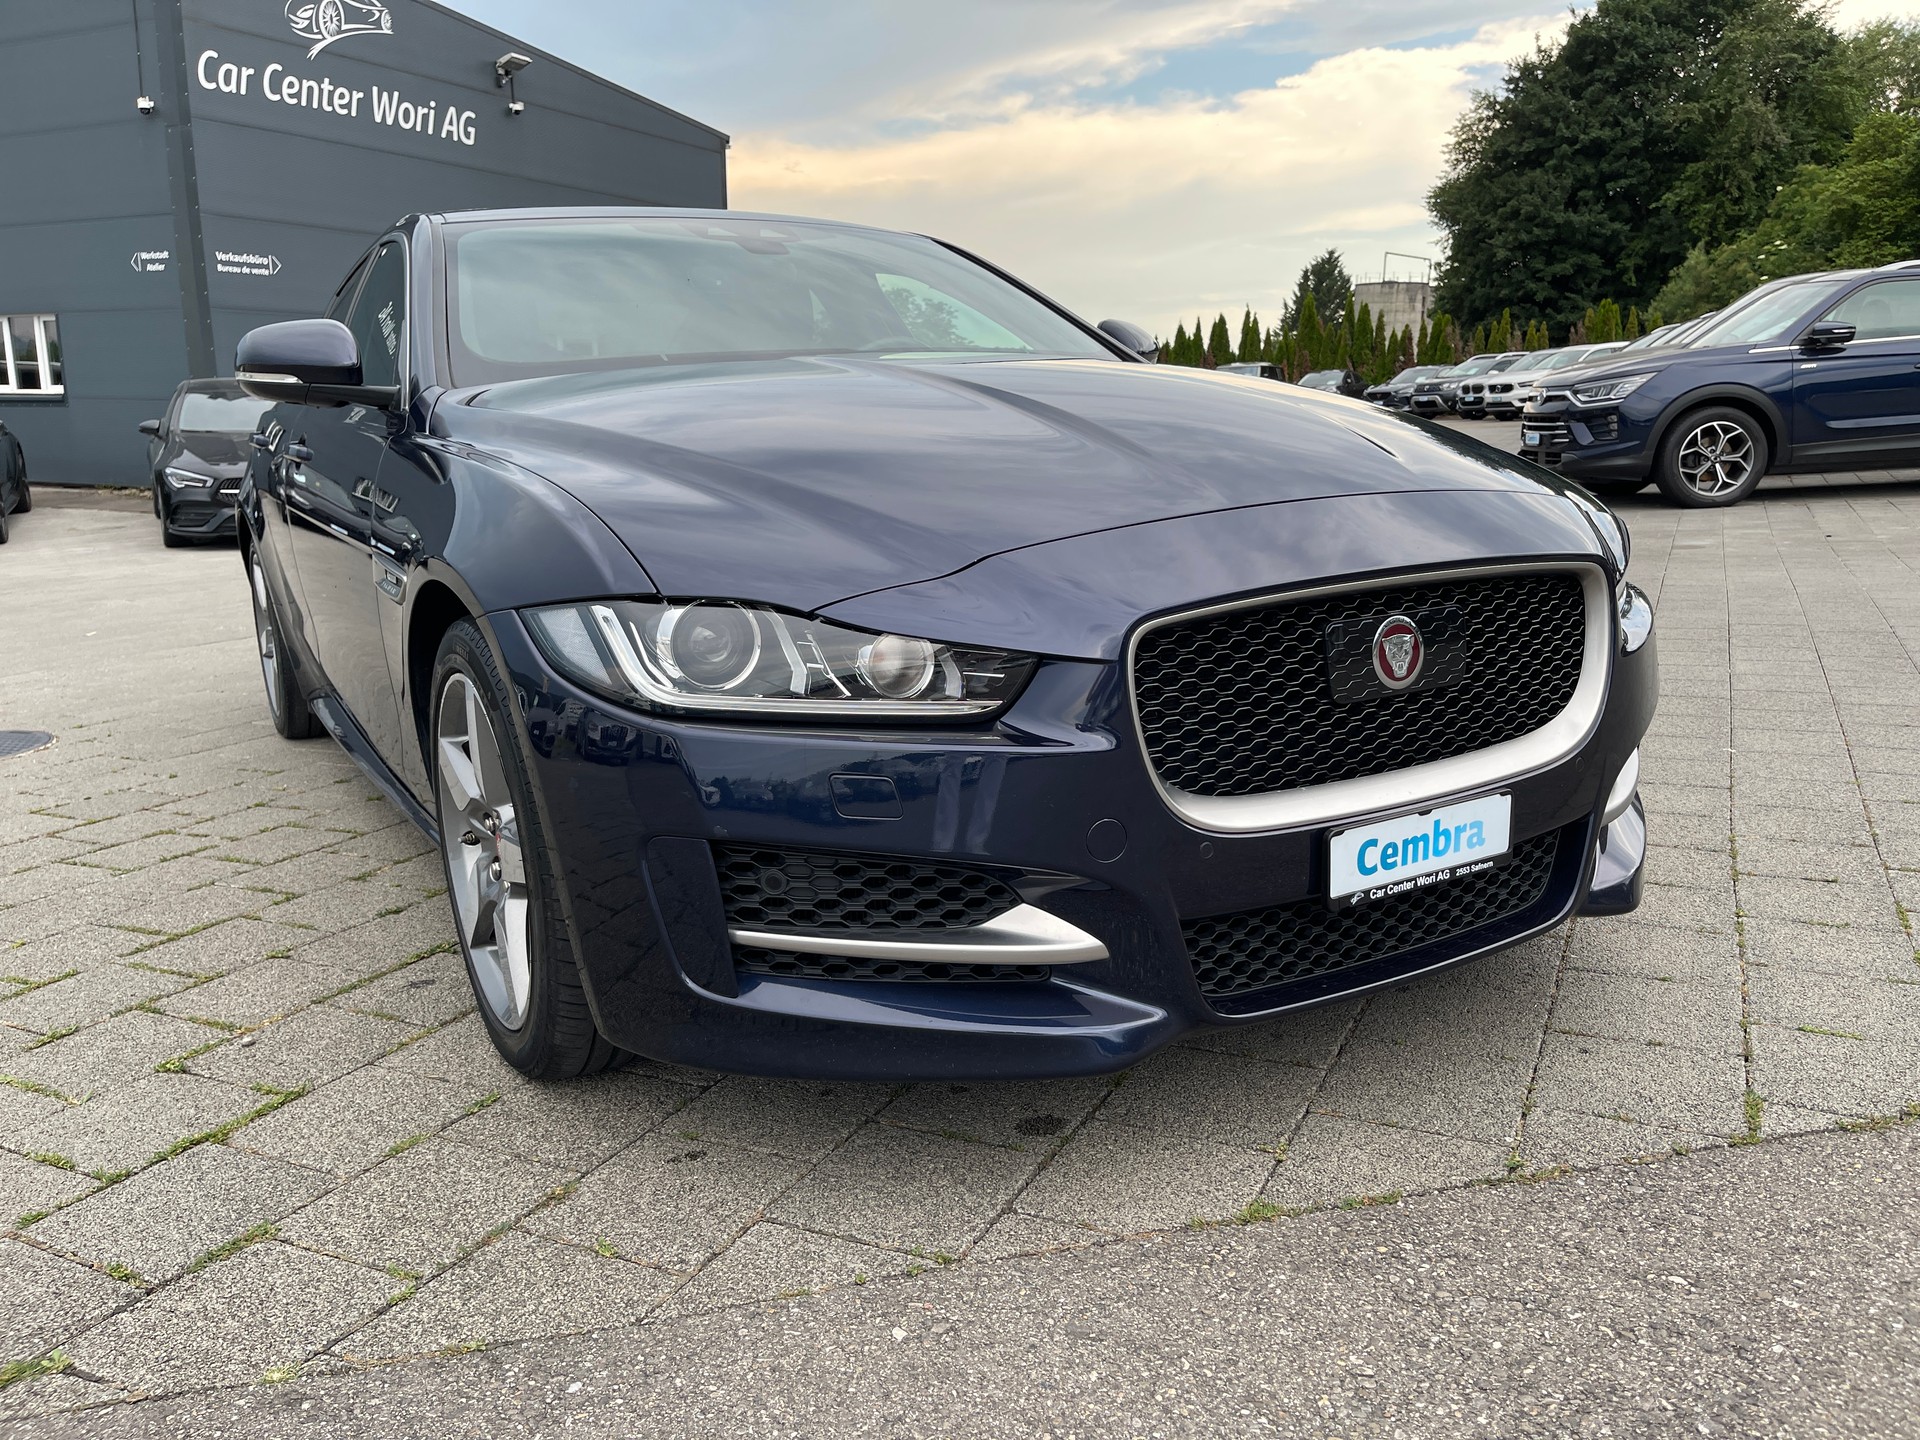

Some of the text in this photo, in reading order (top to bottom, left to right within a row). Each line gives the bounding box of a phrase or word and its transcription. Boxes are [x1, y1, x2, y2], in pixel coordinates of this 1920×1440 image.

[197, 50, 477, 146] Car Center Wori AG
[146, 262, 166, 271] Atelier
[215, 251, 269, 265] Verkaufsbüro
[217, 263, 270, 276] Bureau de vente
[1356, 818, 1486, 877] Cembra
[1369, 860, 1494, 899] Car Center Wori AG 2553 Safnern
